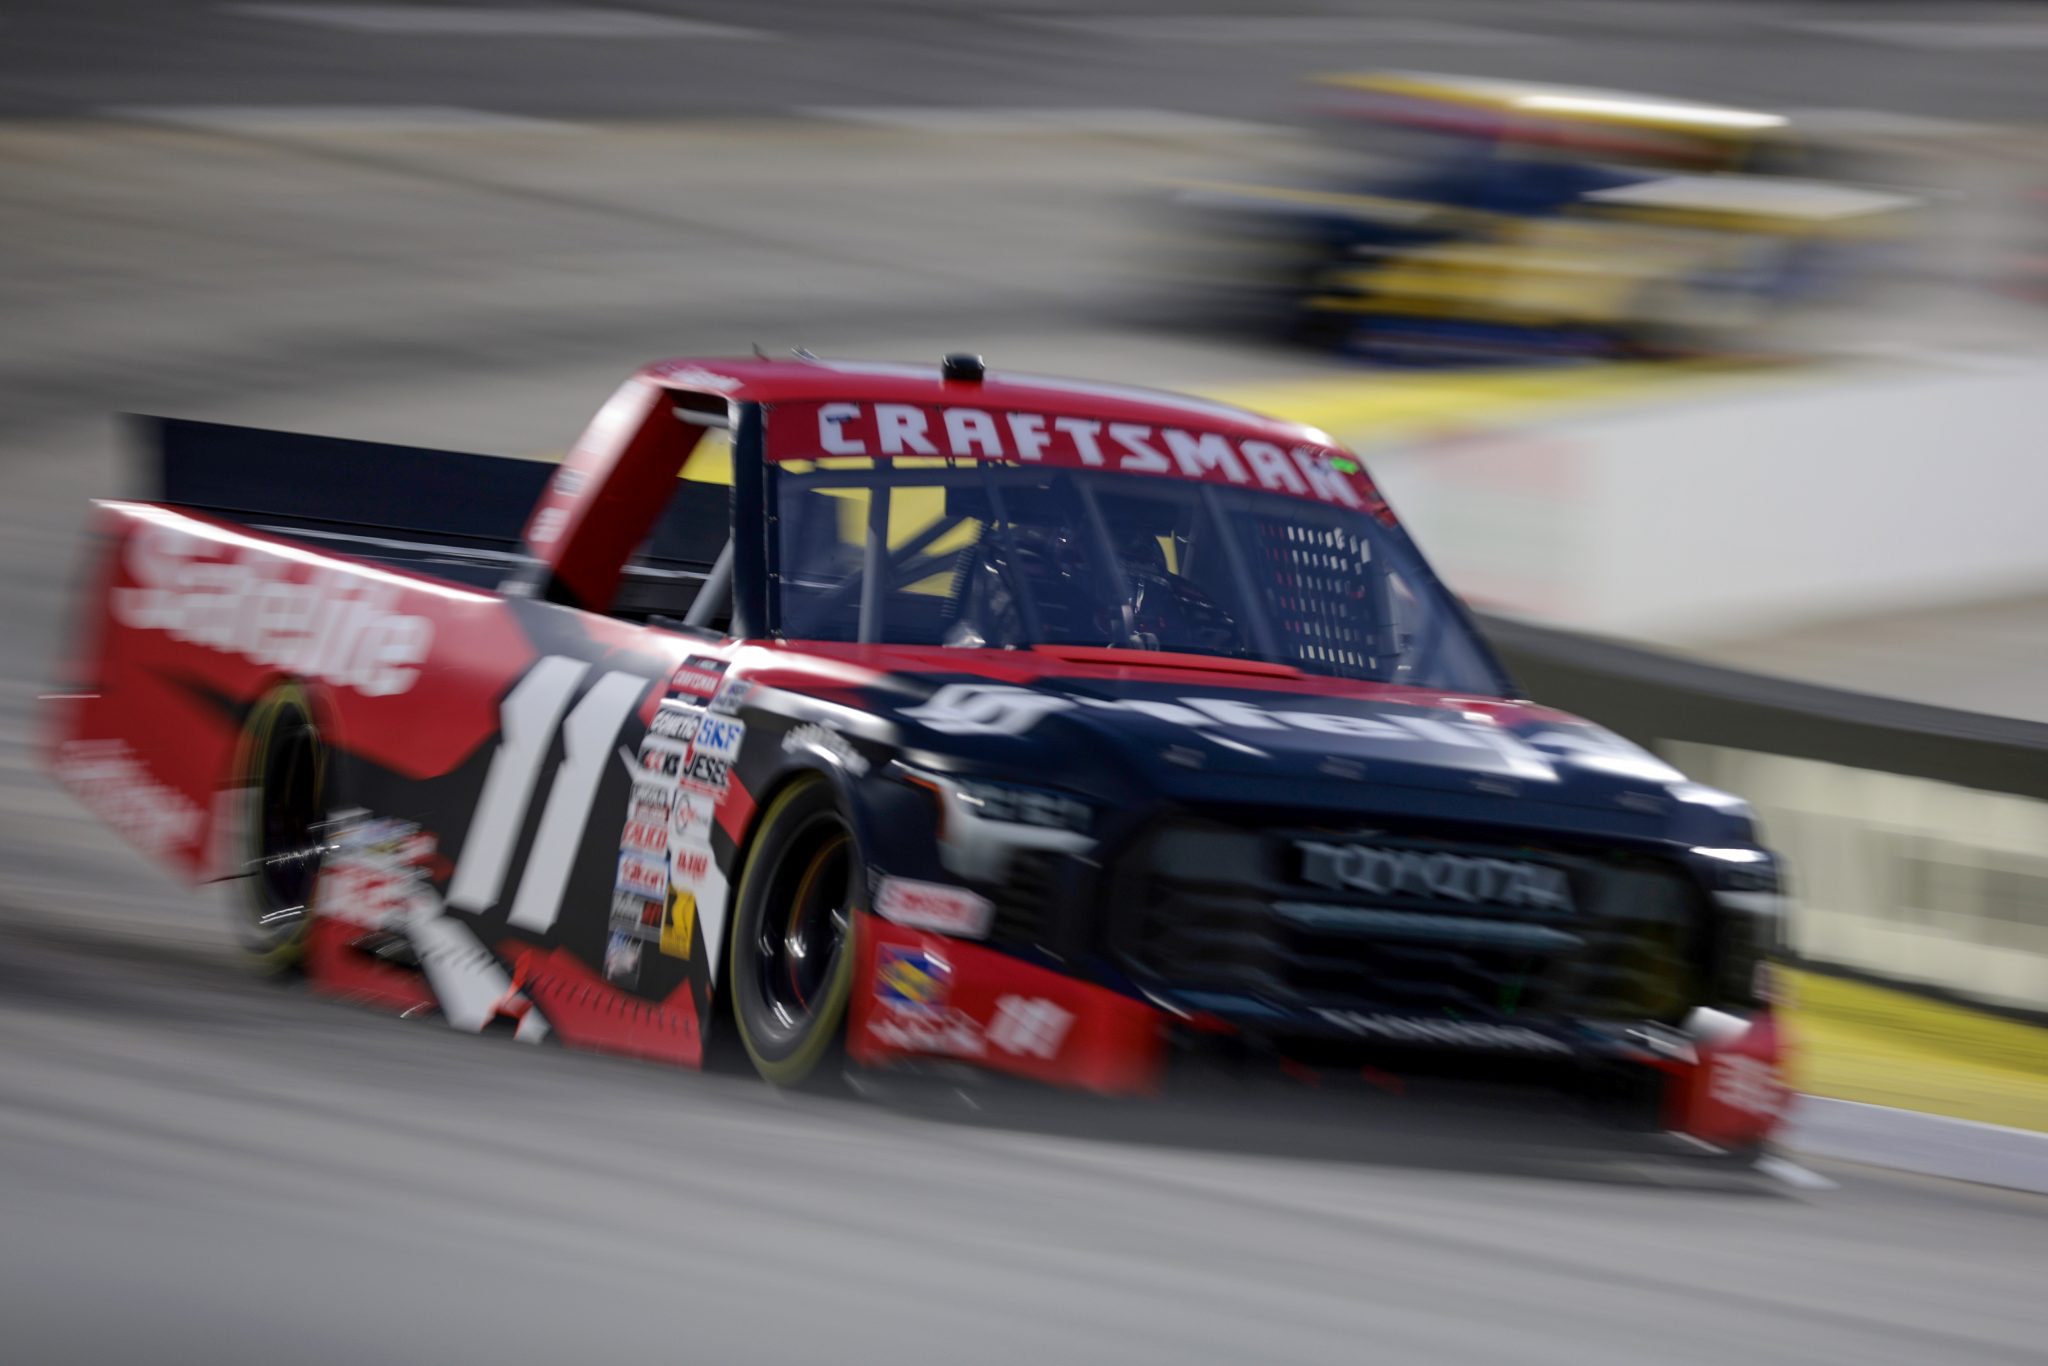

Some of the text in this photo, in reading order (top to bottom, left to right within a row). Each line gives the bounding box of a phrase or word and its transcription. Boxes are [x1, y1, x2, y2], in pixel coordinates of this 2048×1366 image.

[818, 402, 1364, 509] CRAFTSMAN
[697, 718, 742, 750] SKF
[446, 654, 650, 935] 11
[1293, 840, 1577, 912] TOYOTA
